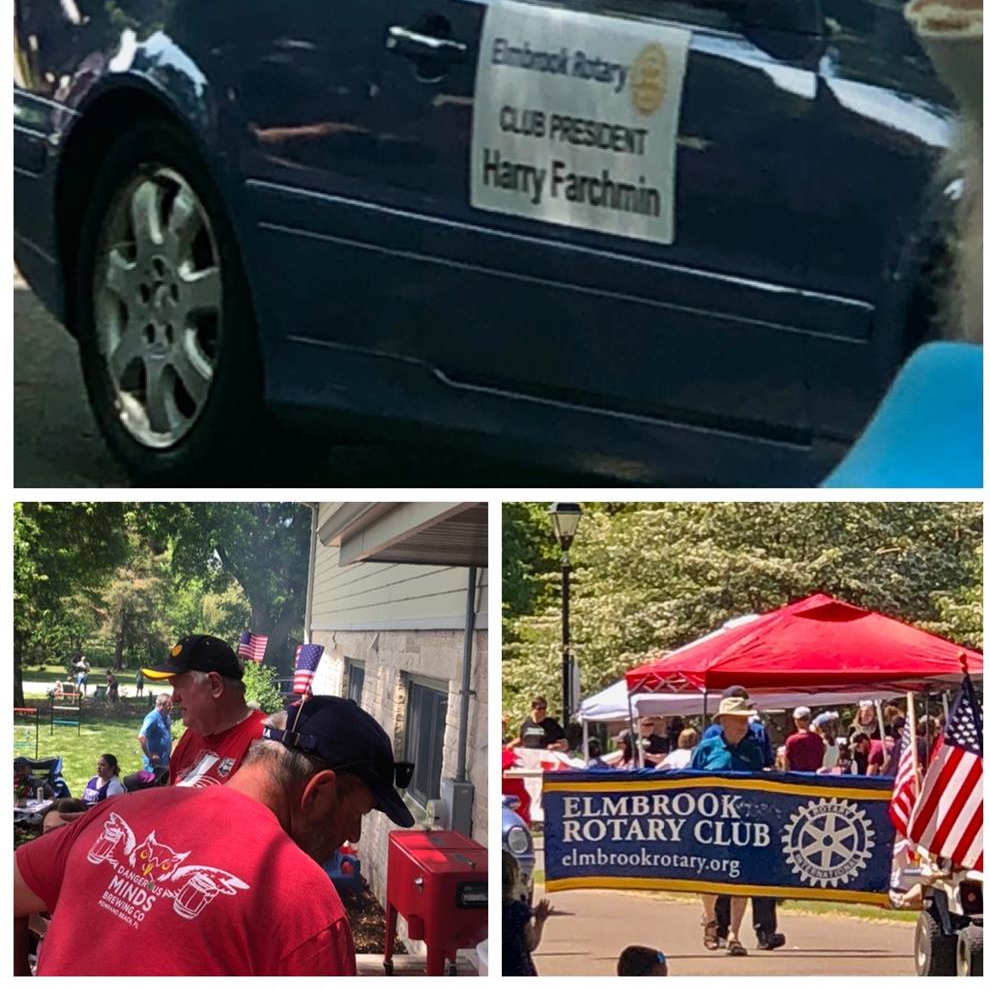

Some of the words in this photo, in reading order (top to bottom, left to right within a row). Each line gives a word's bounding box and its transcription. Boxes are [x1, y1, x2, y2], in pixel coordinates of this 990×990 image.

[492, 38, 568, 75] Elmbrook
[571, 51, 630, 93] Rotary
[499, 105, 545, 138] CLUB
[549, 114, 648, 155] PRESIDENT
[482, 148, 547, 205] Harry
[551, 161, 661, 217] Farchmin
[562, 793, 742, 819] ELMBROOK
[562, 818, 686, 842] ROTARY
[694, 820, 771, 847] CLUB
[562, 848, 741, 878] elmbrookrotary.org
[102, 890, 135, 915] BREWING
[133, 909, 145, 922] CO
[108, 875, 157, 912] MINDS
